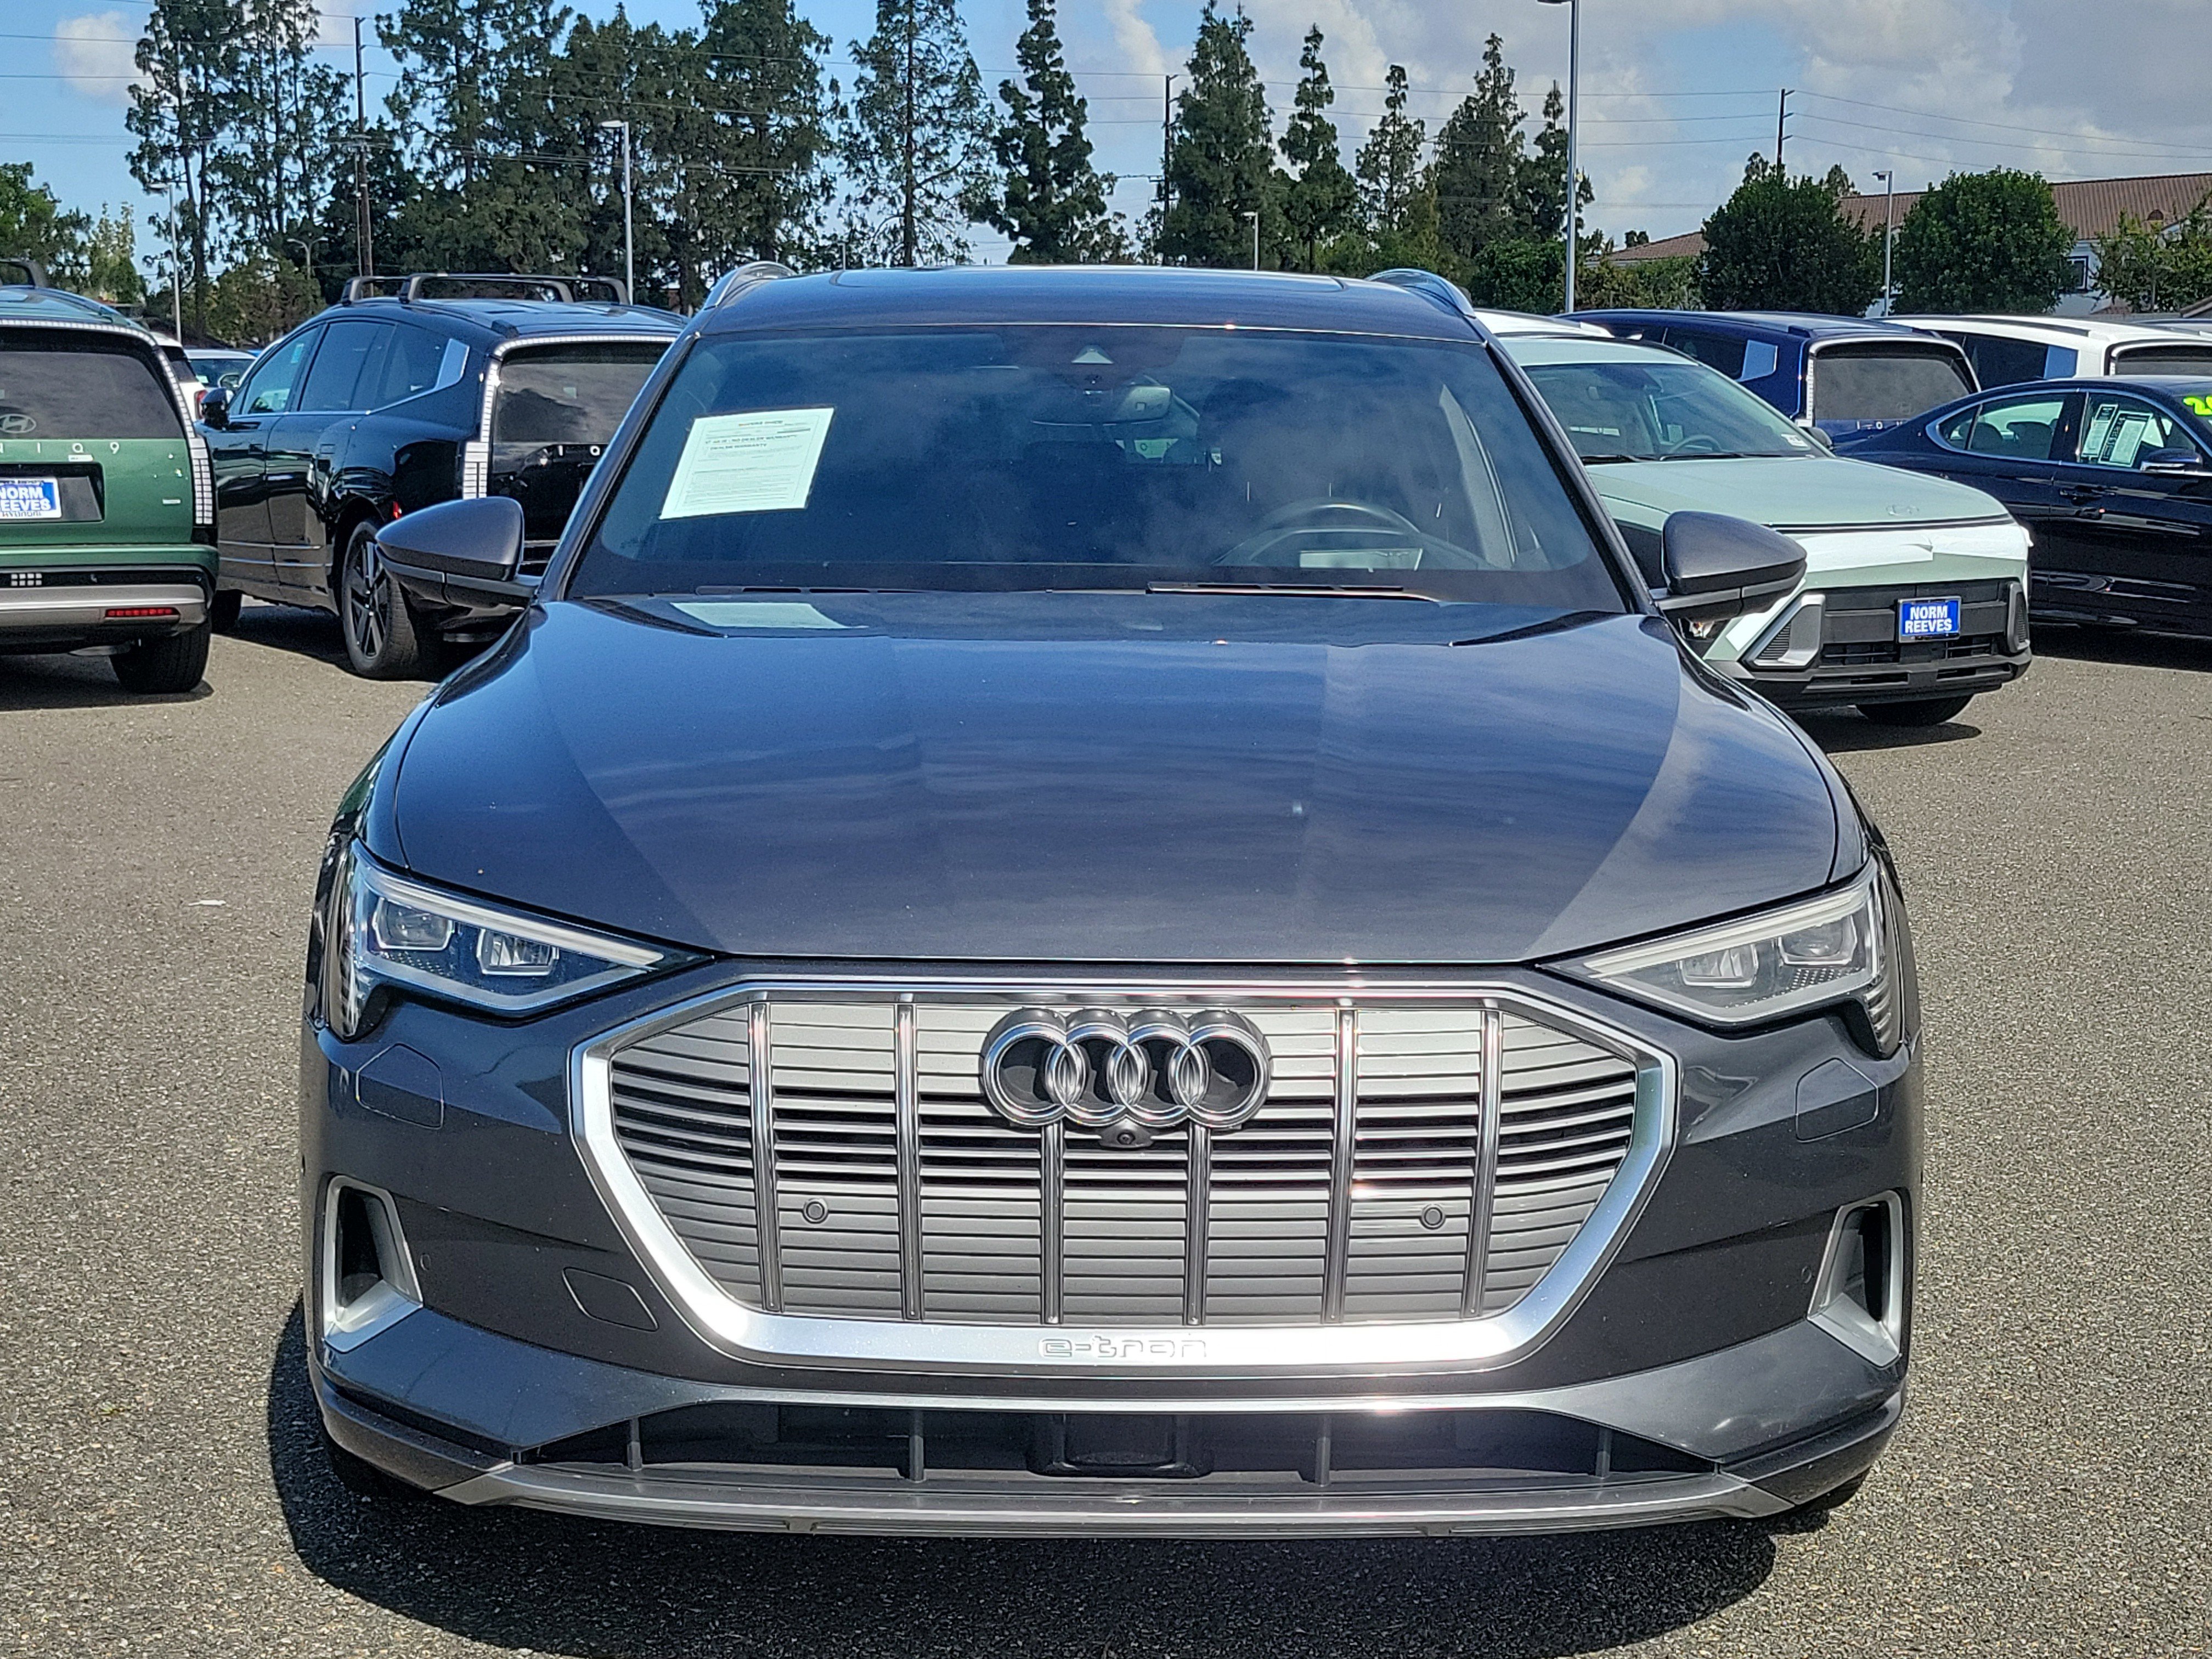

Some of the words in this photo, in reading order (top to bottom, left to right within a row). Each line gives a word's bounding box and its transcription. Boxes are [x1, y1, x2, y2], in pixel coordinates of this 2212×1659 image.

[0, 498, 52, 511] EEVES
[1910, 605, 1948, 620] NORM
[1905, 618, 1953, 634] REEVES
[1039, 1335, 1207, 1358] e-tron
